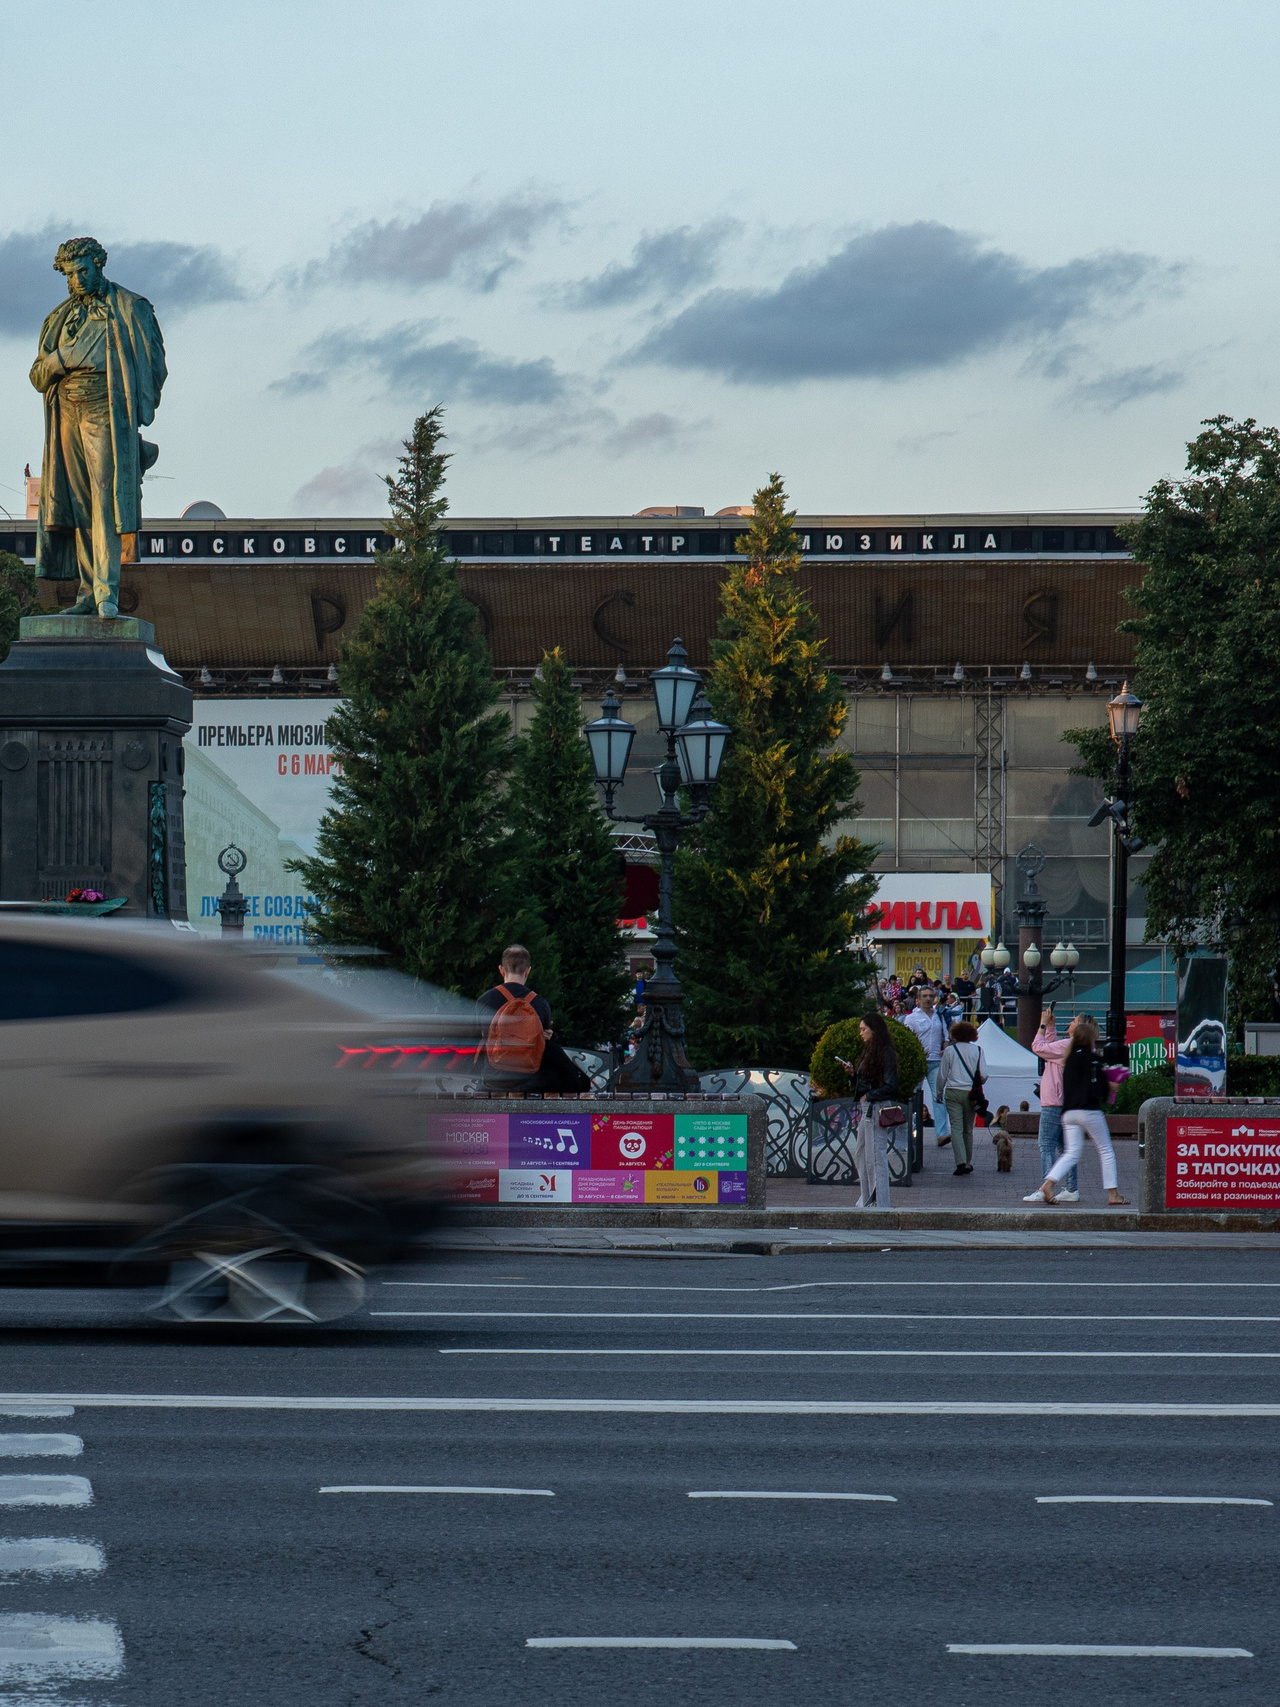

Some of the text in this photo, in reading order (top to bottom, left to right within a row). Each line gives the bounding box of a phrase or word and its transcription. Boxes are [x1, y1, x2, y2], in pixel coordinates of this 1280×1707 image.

[549, 536, 684, 552] ТЕАТР
[198, 725, 274, 746] ПРЕМЬЕРА
[278, 754, 287, 776] С
[292, 754, 300, 776] 6
[446, 1132, 489, 1143] МОСКВА
[462, 1145, 489, 1155] 2030
[1177, 1144, 1200, 1157] ЗА
[1177, 1163, 1188, 1175] В
[1176, 1179, 1228, 1189] Забирайте
[1224, 1193, 1273, 1201] различных
